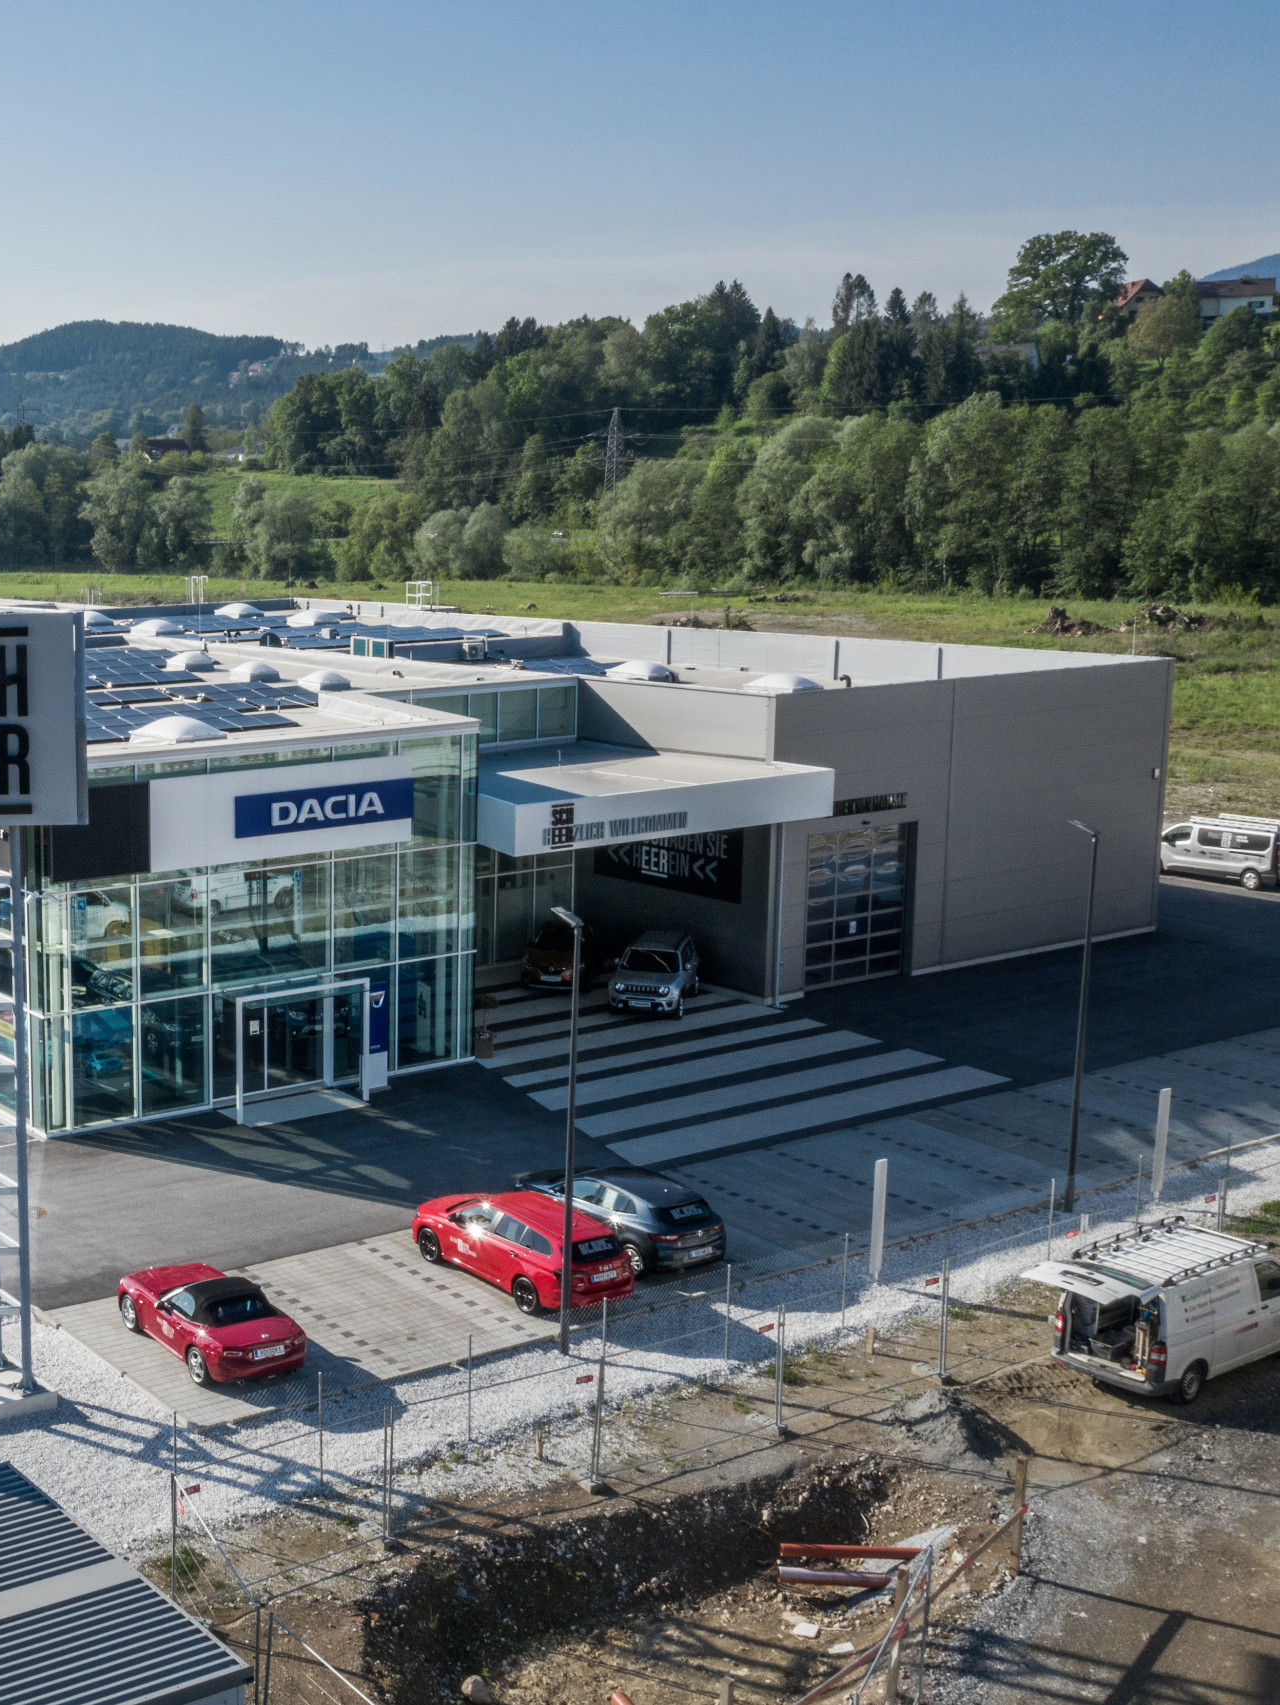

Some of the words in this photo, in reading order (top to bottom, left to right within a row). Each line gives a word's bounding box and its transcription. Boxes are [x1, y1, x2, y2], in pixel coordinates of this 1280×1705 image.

[271, 791, 385, 827] DACIA
[551, 807, 575, 827] SCH
[609, 811, 688, 838] WILLKOMMEN
[706, 832, 729, 860] SIE
[632, 844, 690, 879] HEEREIN
